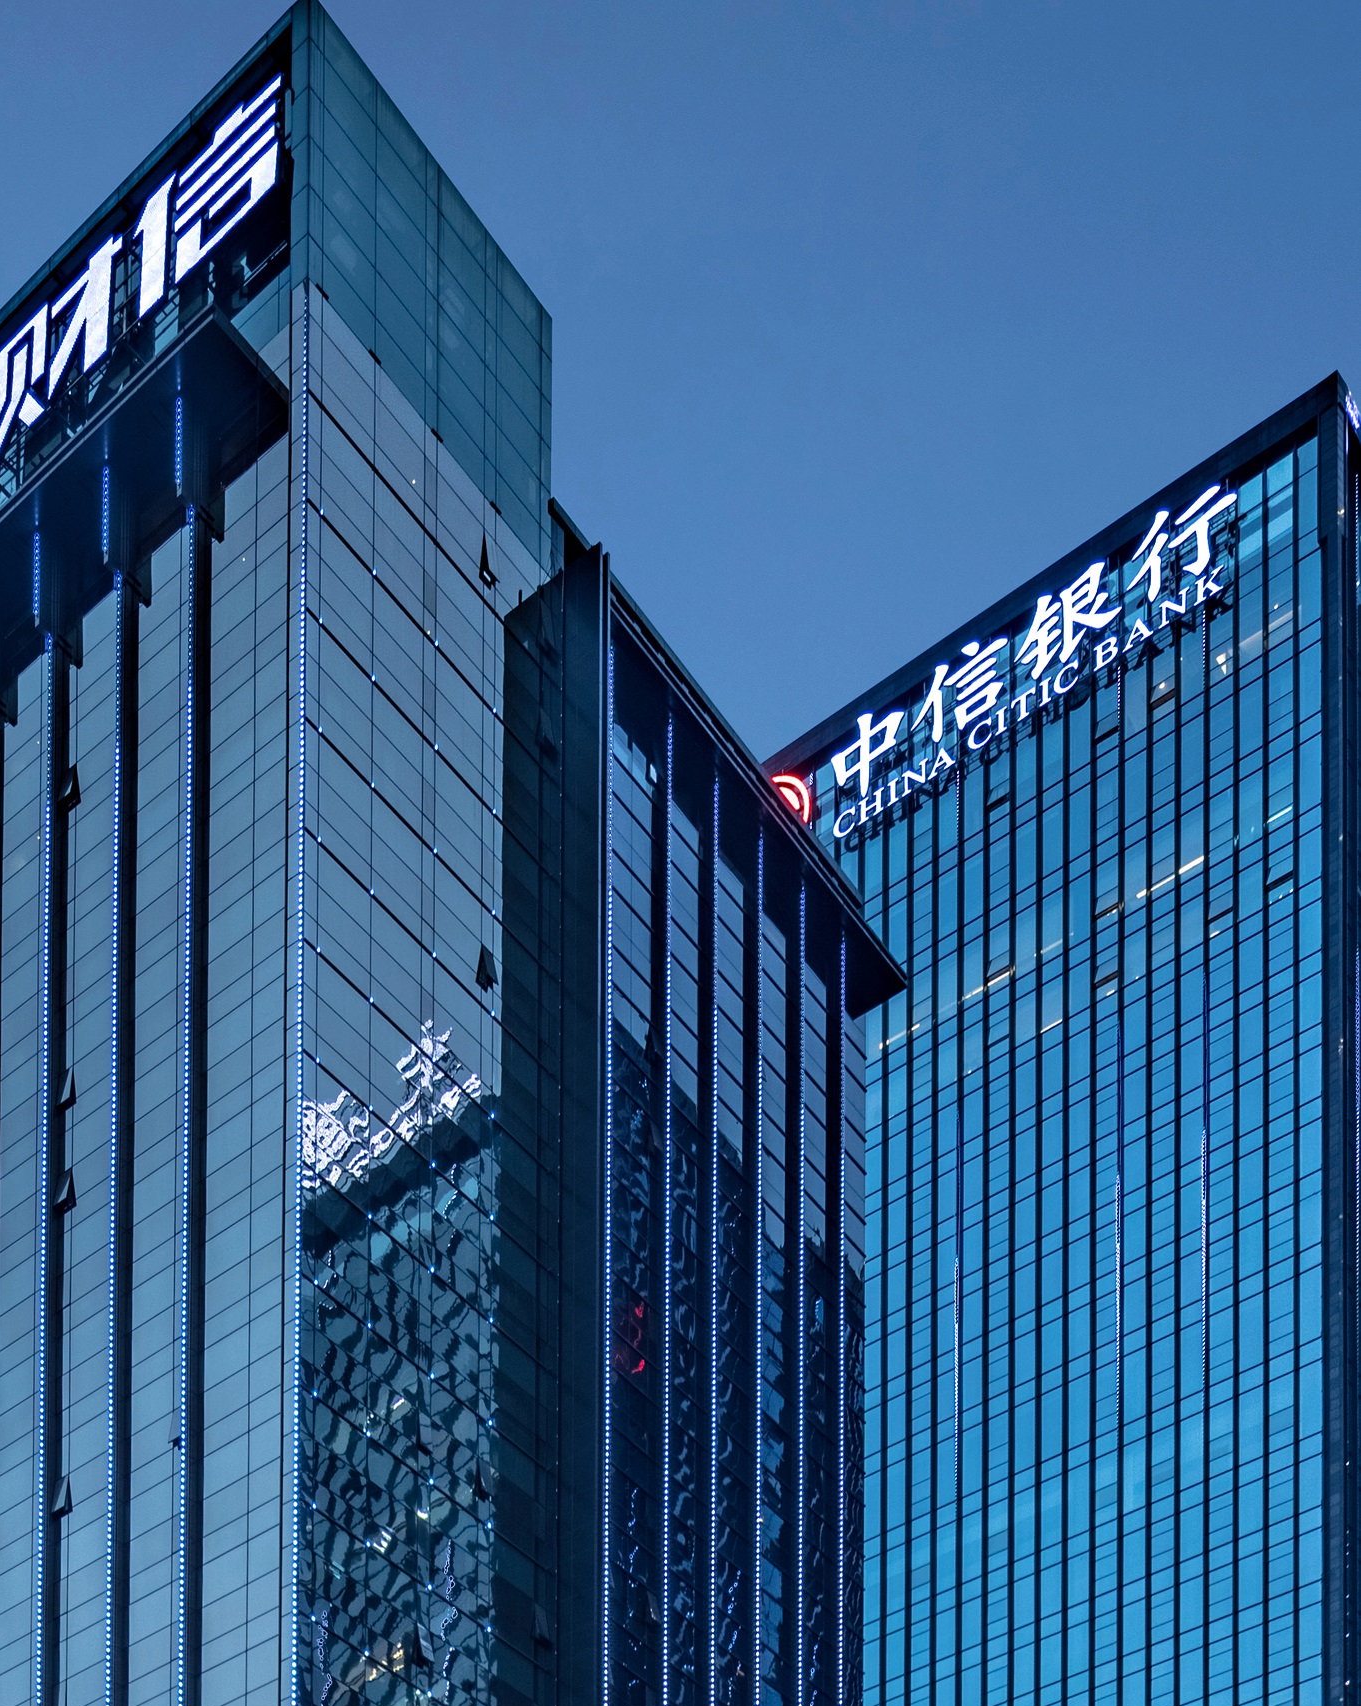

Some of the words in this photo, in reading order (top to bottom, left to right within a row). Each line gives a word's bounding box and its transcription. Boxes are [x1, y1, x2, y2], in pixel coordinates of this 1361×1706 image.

[829, 483, 1238, 797] 中信银行
[832, 749, 956, 840] CHINA
[966, 659, 1082, 750] CITIC
[1093, 564, 1225, 672] BANK
